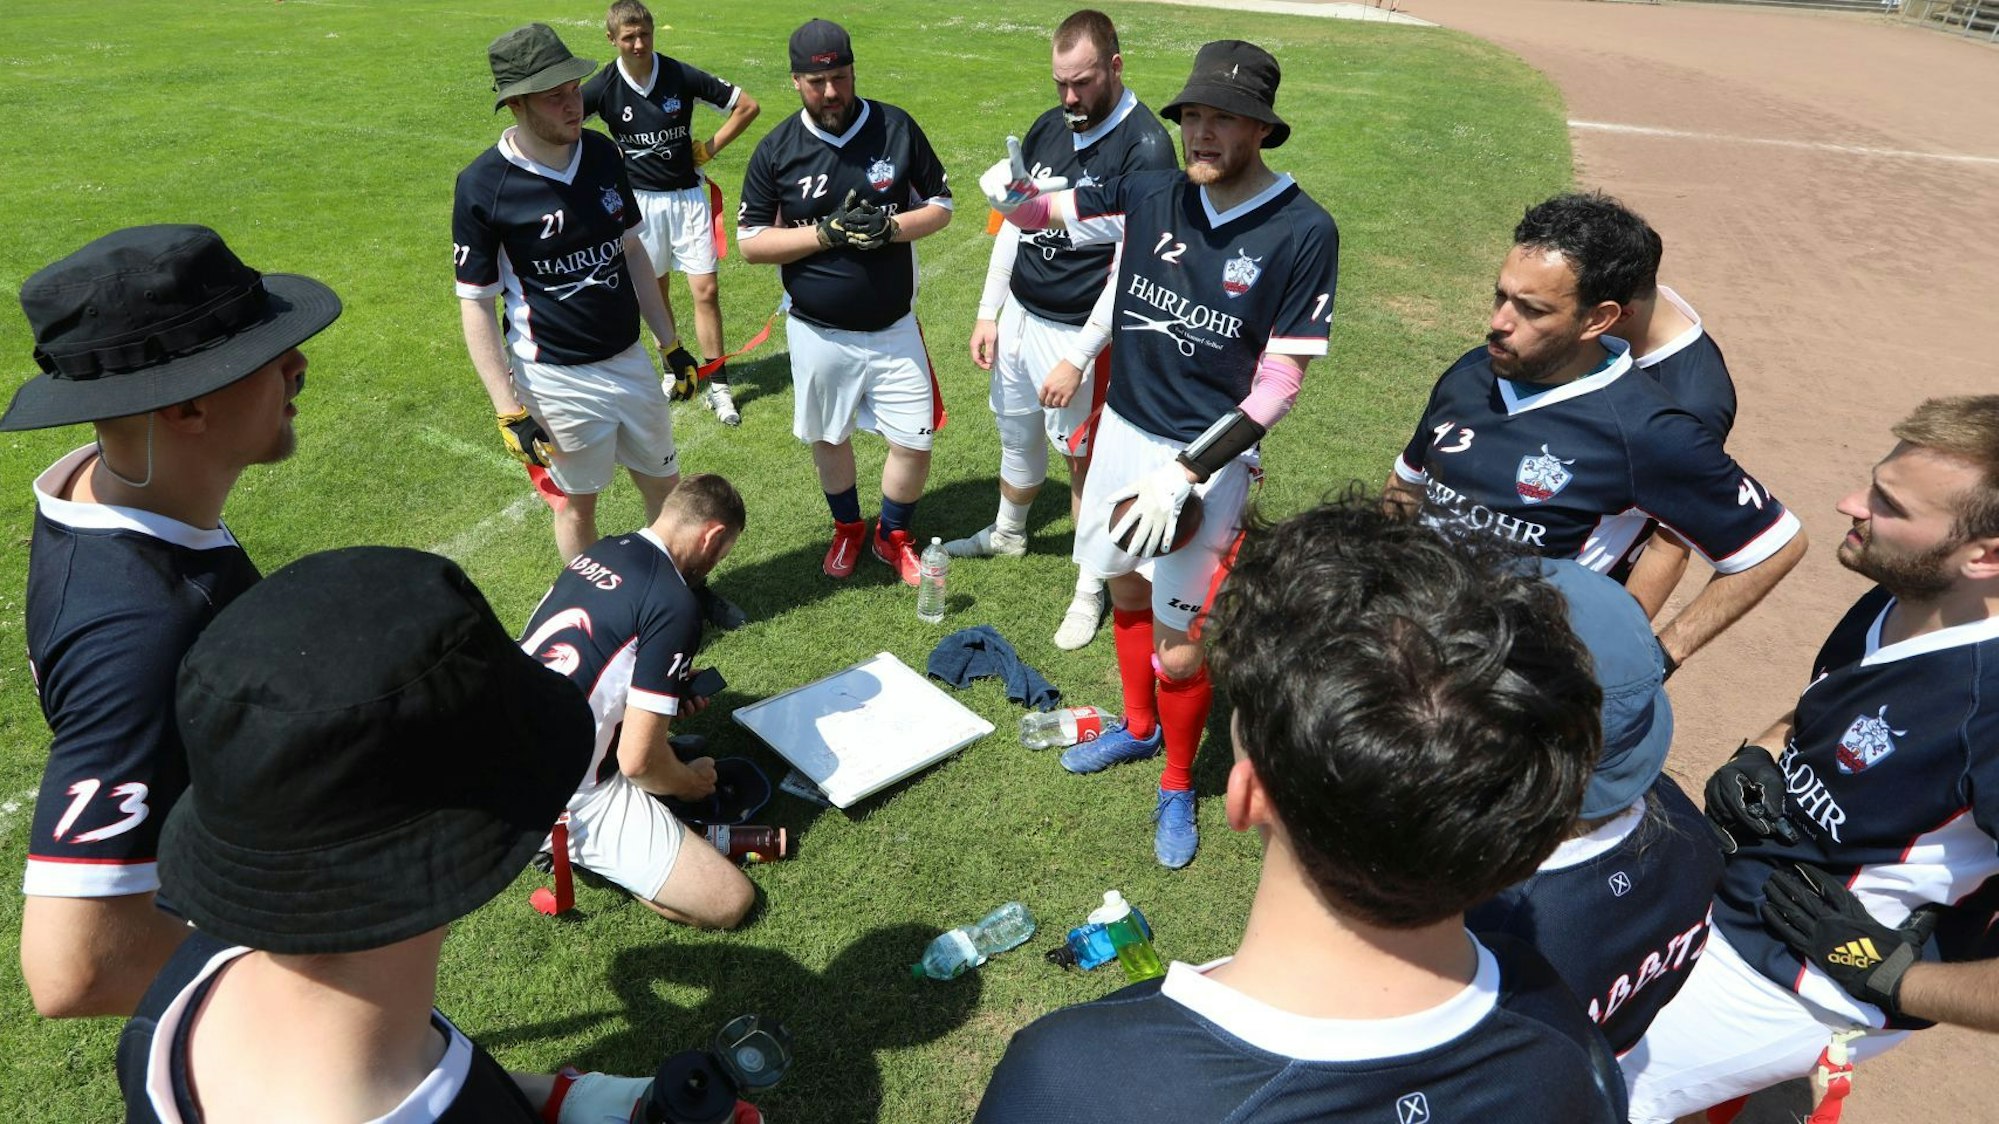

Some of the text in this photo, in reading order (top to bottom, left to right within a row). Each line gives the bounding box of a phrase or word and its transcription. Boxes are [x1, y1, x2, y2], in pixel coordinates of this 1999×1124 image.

[622, 105, 633, 122] 8
[797, 173, 829, 199] 72
[540, 208, 565, 240] 21
[532, 236, 626, 275] HAIRLOH
[1153, 231, 1188, 264] 12
[1128, 273, 1244, 339] HAIRLOHR
[1433, 420, 1475, 453] 43
[1737, 477, 1770, 510] 4
[1167, 597, 1202, 613] Zeu
[53, 778, 150, 844] 13
